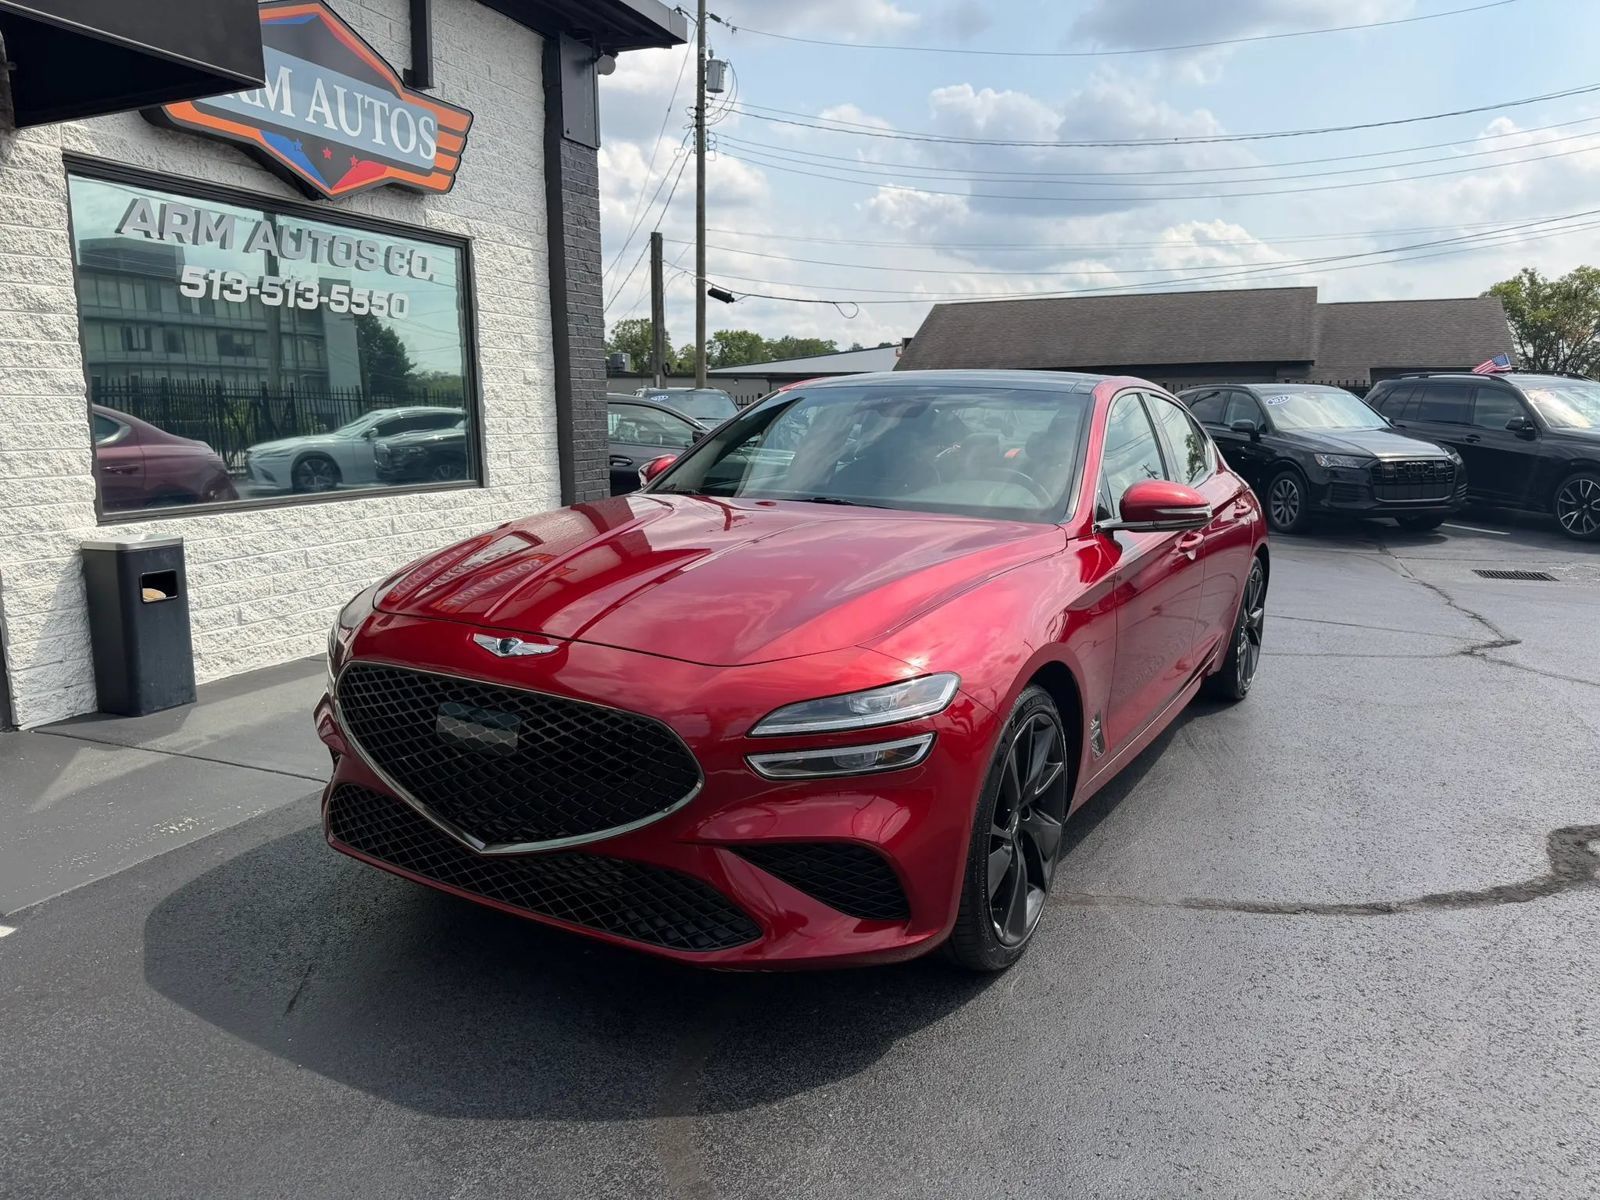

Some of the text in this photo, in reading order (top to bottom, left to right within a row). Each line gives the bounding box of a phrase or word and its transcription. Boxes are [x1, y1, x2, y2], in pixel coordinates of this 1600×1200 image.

[305, 78, 437, 160] AUTOS
[114, 197, 236, 250] ARM
[243, 219, 381, 273] AUTOS
[179, 264, 410, 320] 513-513-5550
